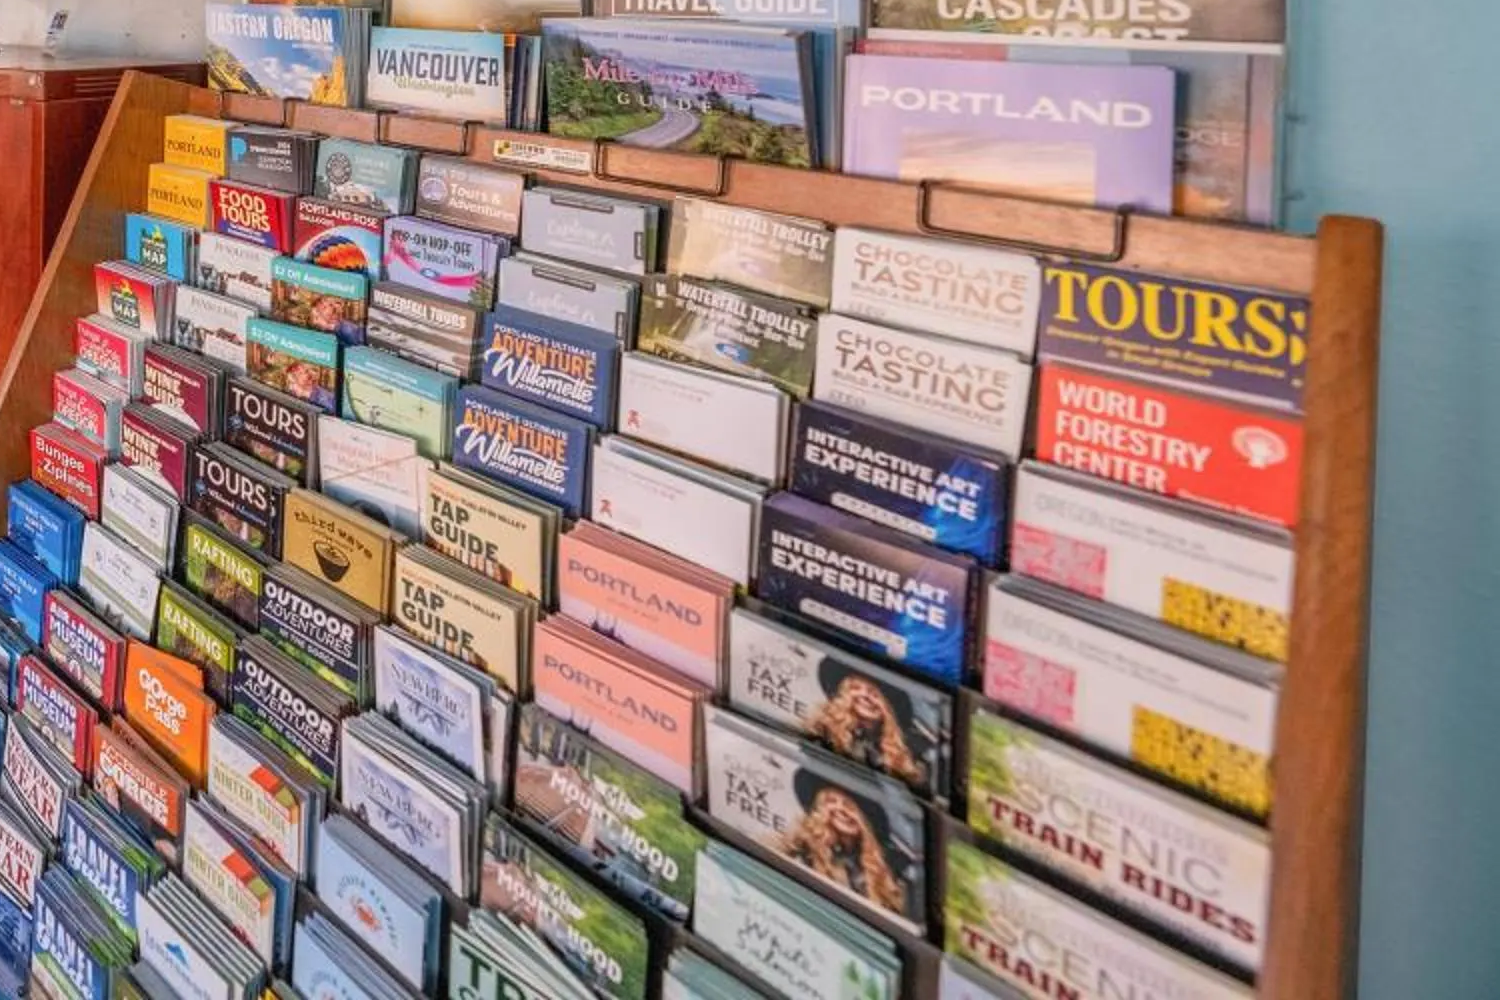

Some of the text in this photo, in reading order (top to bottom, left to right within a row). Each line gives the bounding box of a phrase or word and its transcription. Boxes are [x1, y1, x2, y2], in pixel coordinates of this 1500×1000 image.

[210, 11, 335, 43] EASTERN OREGON
[377, 48, 500, 87] VANCOUVER
[616, 90, 714, 114] GUIDE
[861, 84, 1152, 129] PORTLAND
[167, 139, 221, 159] PORTLAND
[149, 187, 203, 209] PORTLAND
[219, 187, 266, 213] FOOD
[299, 201, 351, 221] PORTLAND
[450, 182, 488, 201] Tours
[220, 204, 271, 233] TOURS
[772, 220, 830, 251] TROLLEY
[141, 250, 167, 264] MAP
[429, 236, 473, 257] HOP-OFF
[855, 242, 1027, 291] CHOCOLATE
[374, 290, 467, 330] WATERFALL TOURS
[678, 281, 749, 318] WATERFALL
[751, 305, 810, 339] TROLLEY
[854, 259, 1025, 315] TASTING
[1045, 268, 1288, 358] TOURS
[484, 348, 597, 402] Willamette
[491, 332, 595, 379] ADVENTURE
[551, 339, 597, 361] ULTIMATE
[837, 329, 1011, 389] CHOCOLATE
[145, 363, 181, 395] WINE
[835, 346, 1005, 413] TASTING
[1058, 379, 1167, 429] WORLD
[231, 387, 305, 439] TOURS
[463, 408, 566, 461] ADVENTURE
[35, 436, 85, 473] Bungee
[123, 426, 160, 459] WINE
[455, 425, 569, 483] Willamette
[807, 427, 982, 498] INTERACTIVE ART
[1056, 409, 1213, 473] FORESTRY
[195, 452, 267, 510] TOURS
[805, 444, 978, 521] EXPERIENCE
[1053, 441, 1168, 493] CENTER
[294, 508, 336, 534] third
[430, 493, 470, 524] TAP
[193, 535, 253, 587] RAFTING
[430, 517, 499, 561] GUIDE
[771, 529, 949, 604] INTERACTIVE ART
[771, 547, 948, 630] EXPERIENCE
[50, 601, 69, 624] AIR
[264, 581, 355, 646] OUTDOOR
[402, 578, 445, 612] TAP
[567, 559, 702, 627] PORTLAND
[50, 616, 104, 674] MUSEUM
[164, 603, 223, 661] RAFTING
[264, 599, 351, 659] ADVENTURES
[401, 600, 475, 651] GUIDE
[240, 660, 334, 743] OUTDOOR
[543, 653, 678, 733] PORTLAND
[748, 679, 808, 717] FREE
[749, 661, 792, 692] TAX
[23, 679, 76, 741] MUSEUM
[145, 696, 180, 735] Pass
[243, 679, 331, 753] ADVENTURES
[725, 771, 768, 805] TAX
[726, 793, 787, 833] FREE
[551, 772, 618, 829] MOUNT
[621, 825, 679, 884] HOOD
[1013, 781, 1224, 898] SCENIC
[67, 812, 128, 896] TRAVEL
[987, 797, 1256, 945] TRAIN RIDES
[36, 892, 93, 980] TRAVEL
[497, 867, 623, 985] MOUNT HOOD
